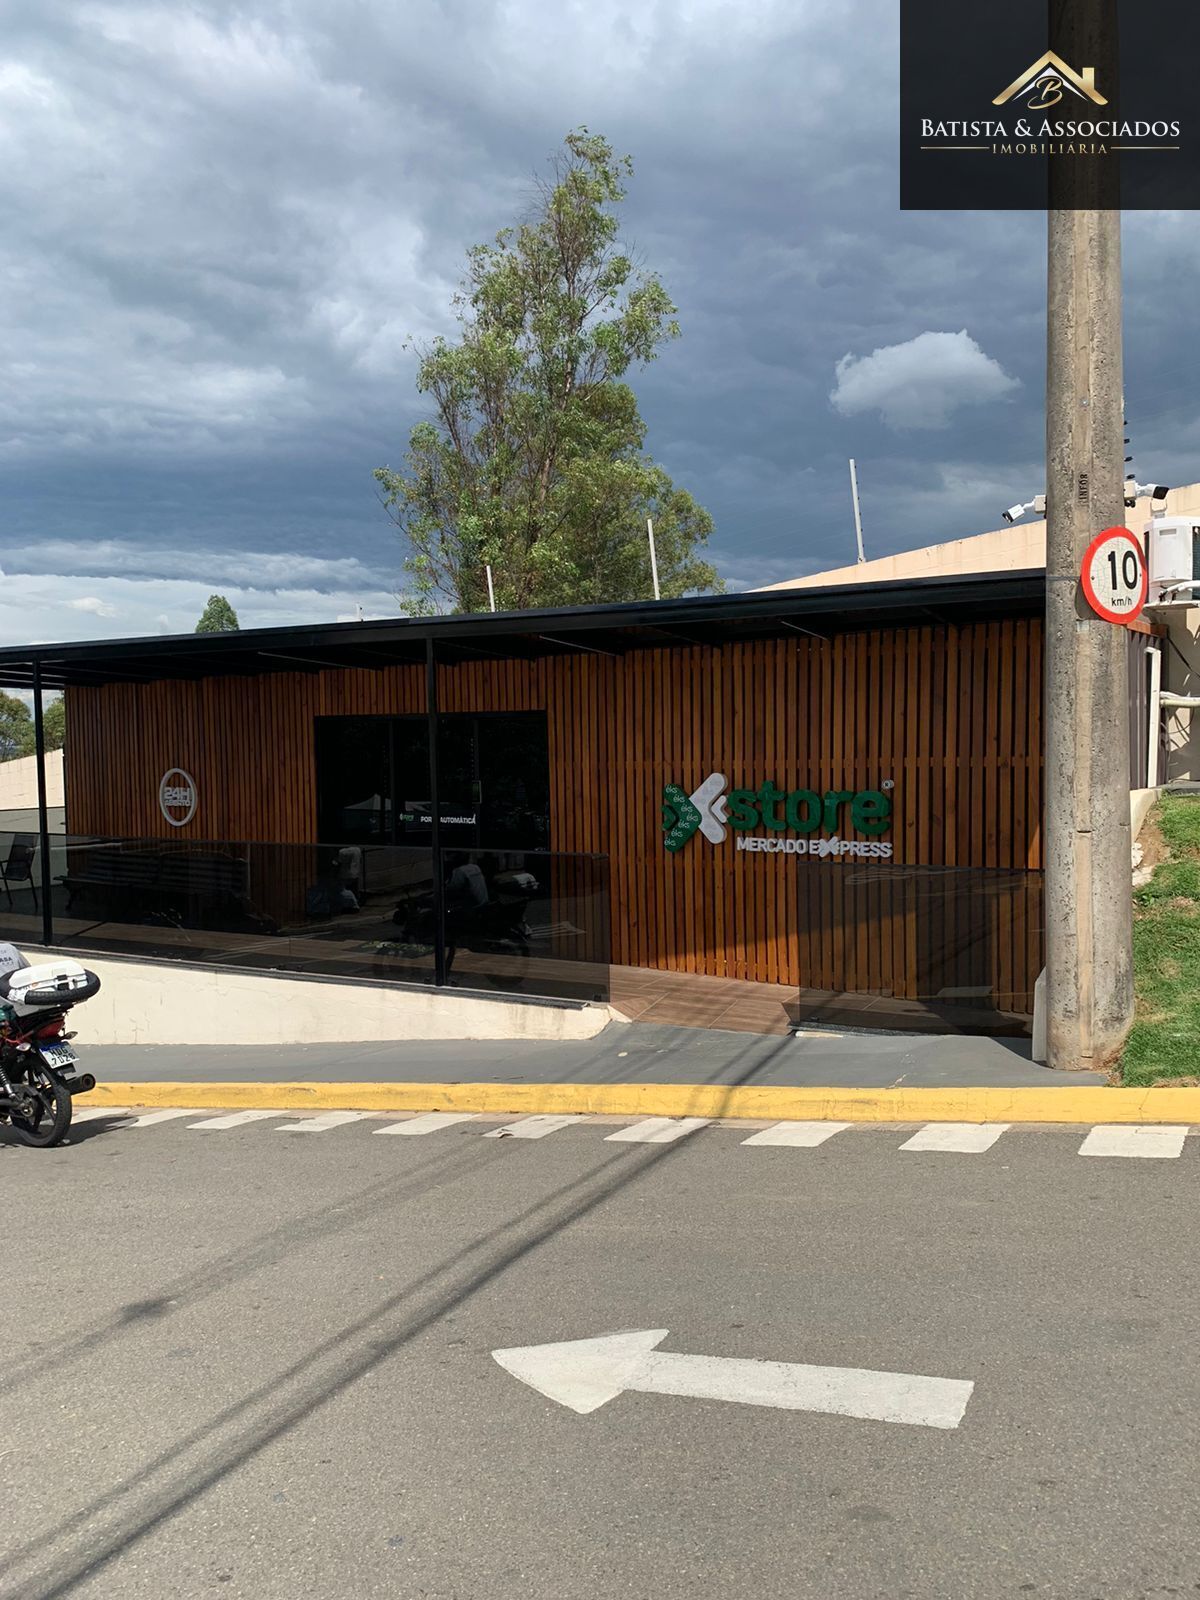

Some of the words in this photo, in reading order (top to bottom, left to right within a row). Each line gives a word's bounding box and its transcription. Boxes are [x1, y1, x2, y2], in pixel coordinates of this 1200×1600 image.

[1108, 550, 1138, 590] 10
[1111, 596, 1132, 607] km/h
[736, 836, 808, 855] MERCADO
[809, 836, 893, 858] EXPRESS
